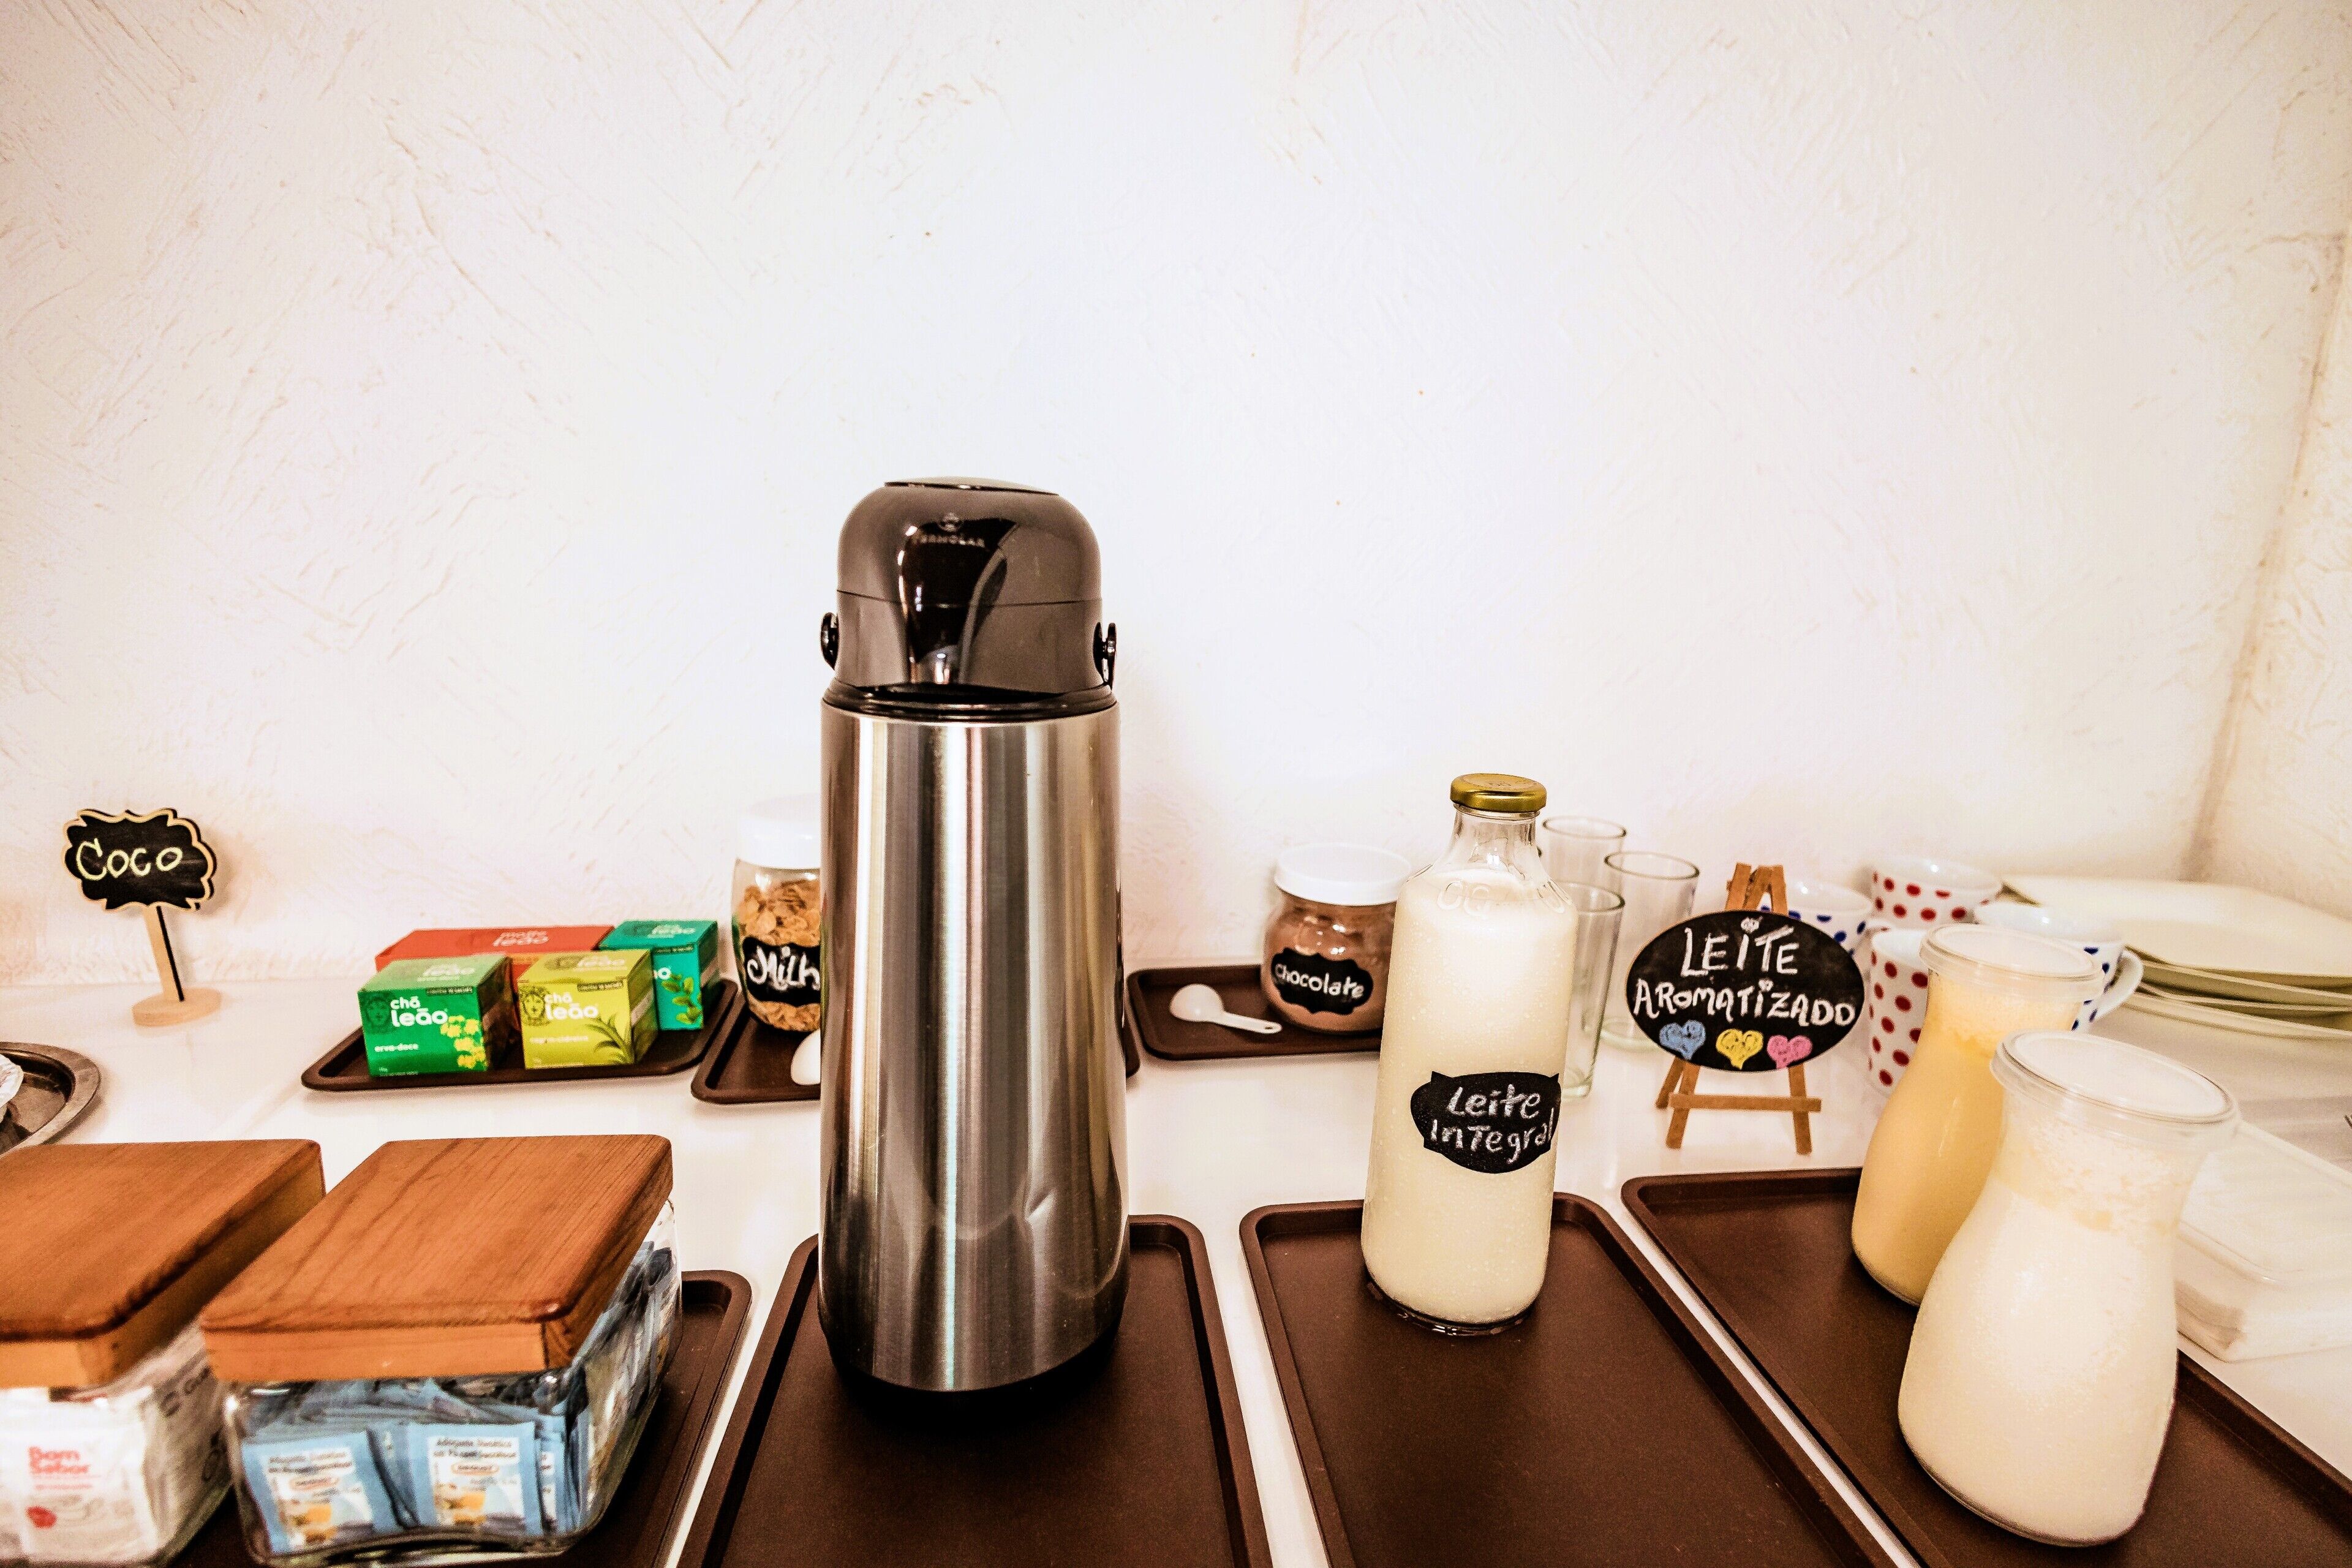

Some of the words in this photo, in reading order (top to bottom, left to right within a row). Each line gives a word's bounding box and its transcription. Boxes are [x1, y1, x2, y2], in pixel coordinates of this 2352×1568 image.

[76, 837, 183, 881] Coco
[747, 945, 821, 990] Milh
[391, 1008, 448, 1027] leão
[545, 1003, 598, 1020] leão
[1446, 1084, 1541, 1119] Leite
